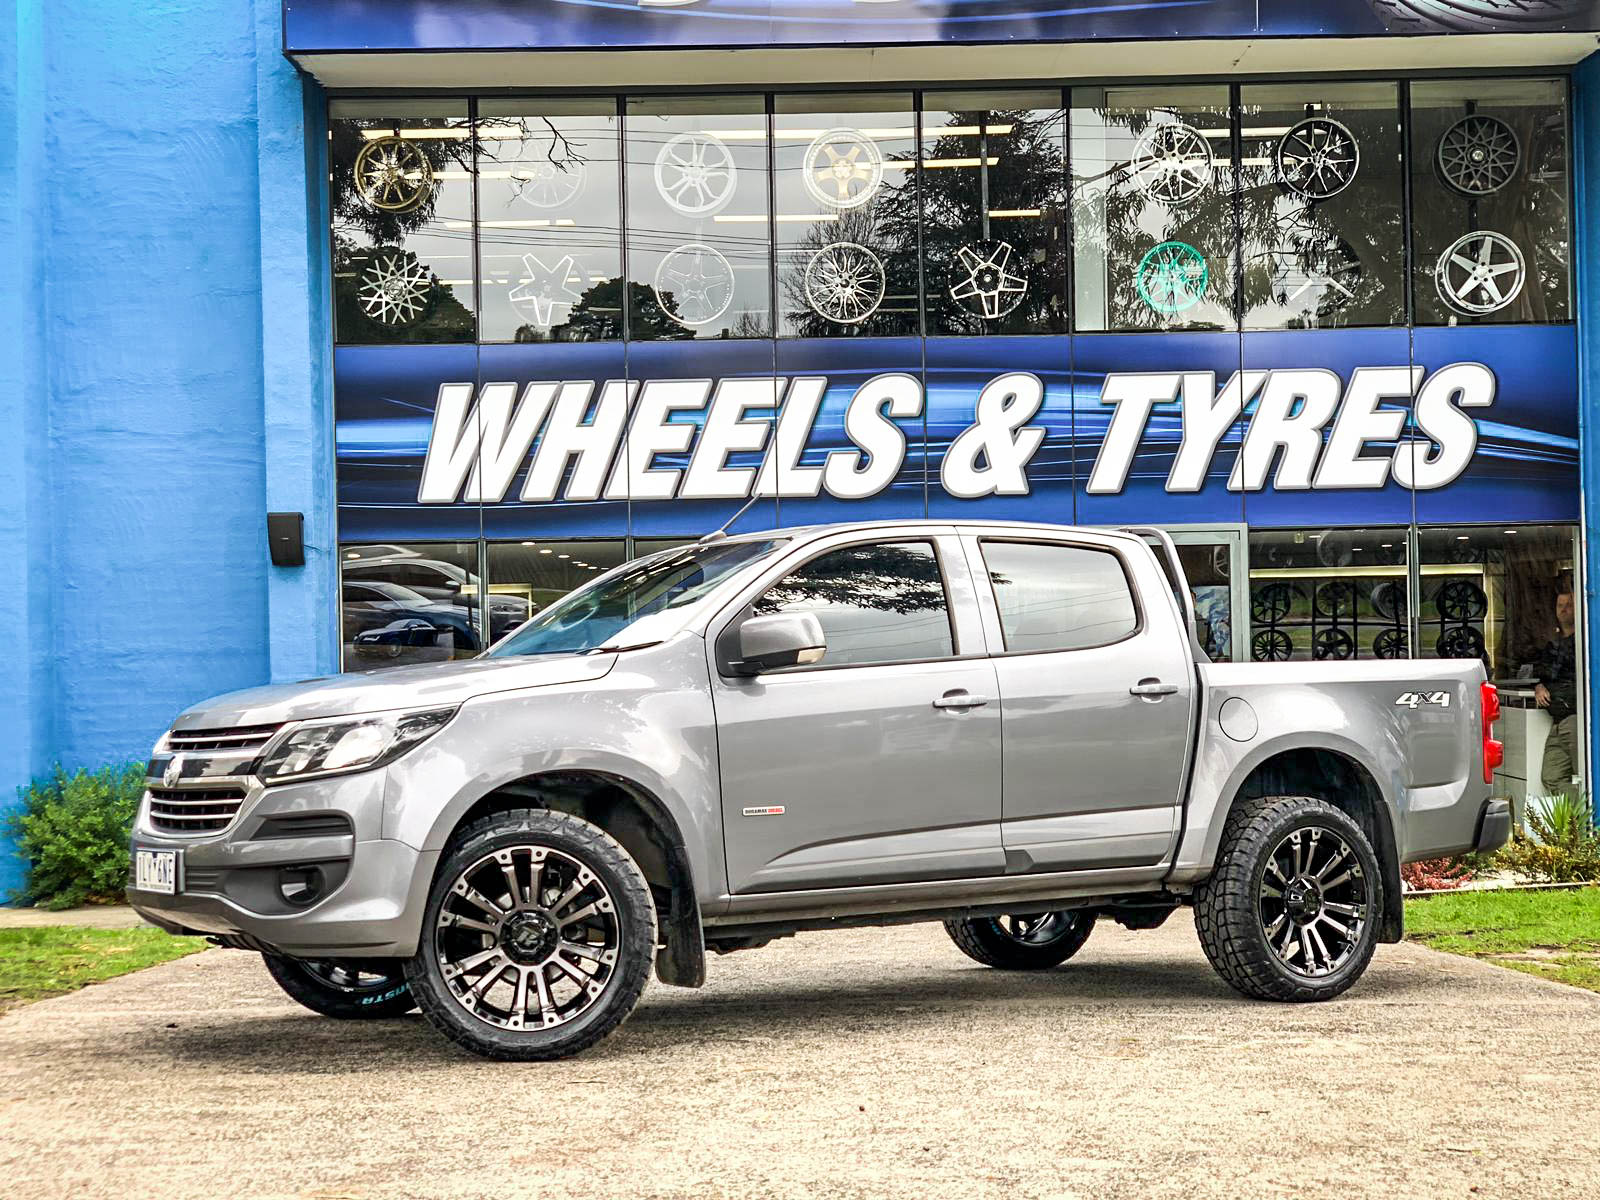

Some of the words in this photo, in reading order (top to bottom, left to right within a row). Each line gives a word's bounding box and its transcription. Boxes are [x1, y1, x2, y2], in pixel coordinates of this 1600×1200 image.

[416, 372, 925, 504] WHEELS
[942, 372, 1047, 498] &
[1086, 362, 1496, 495] TYRES
